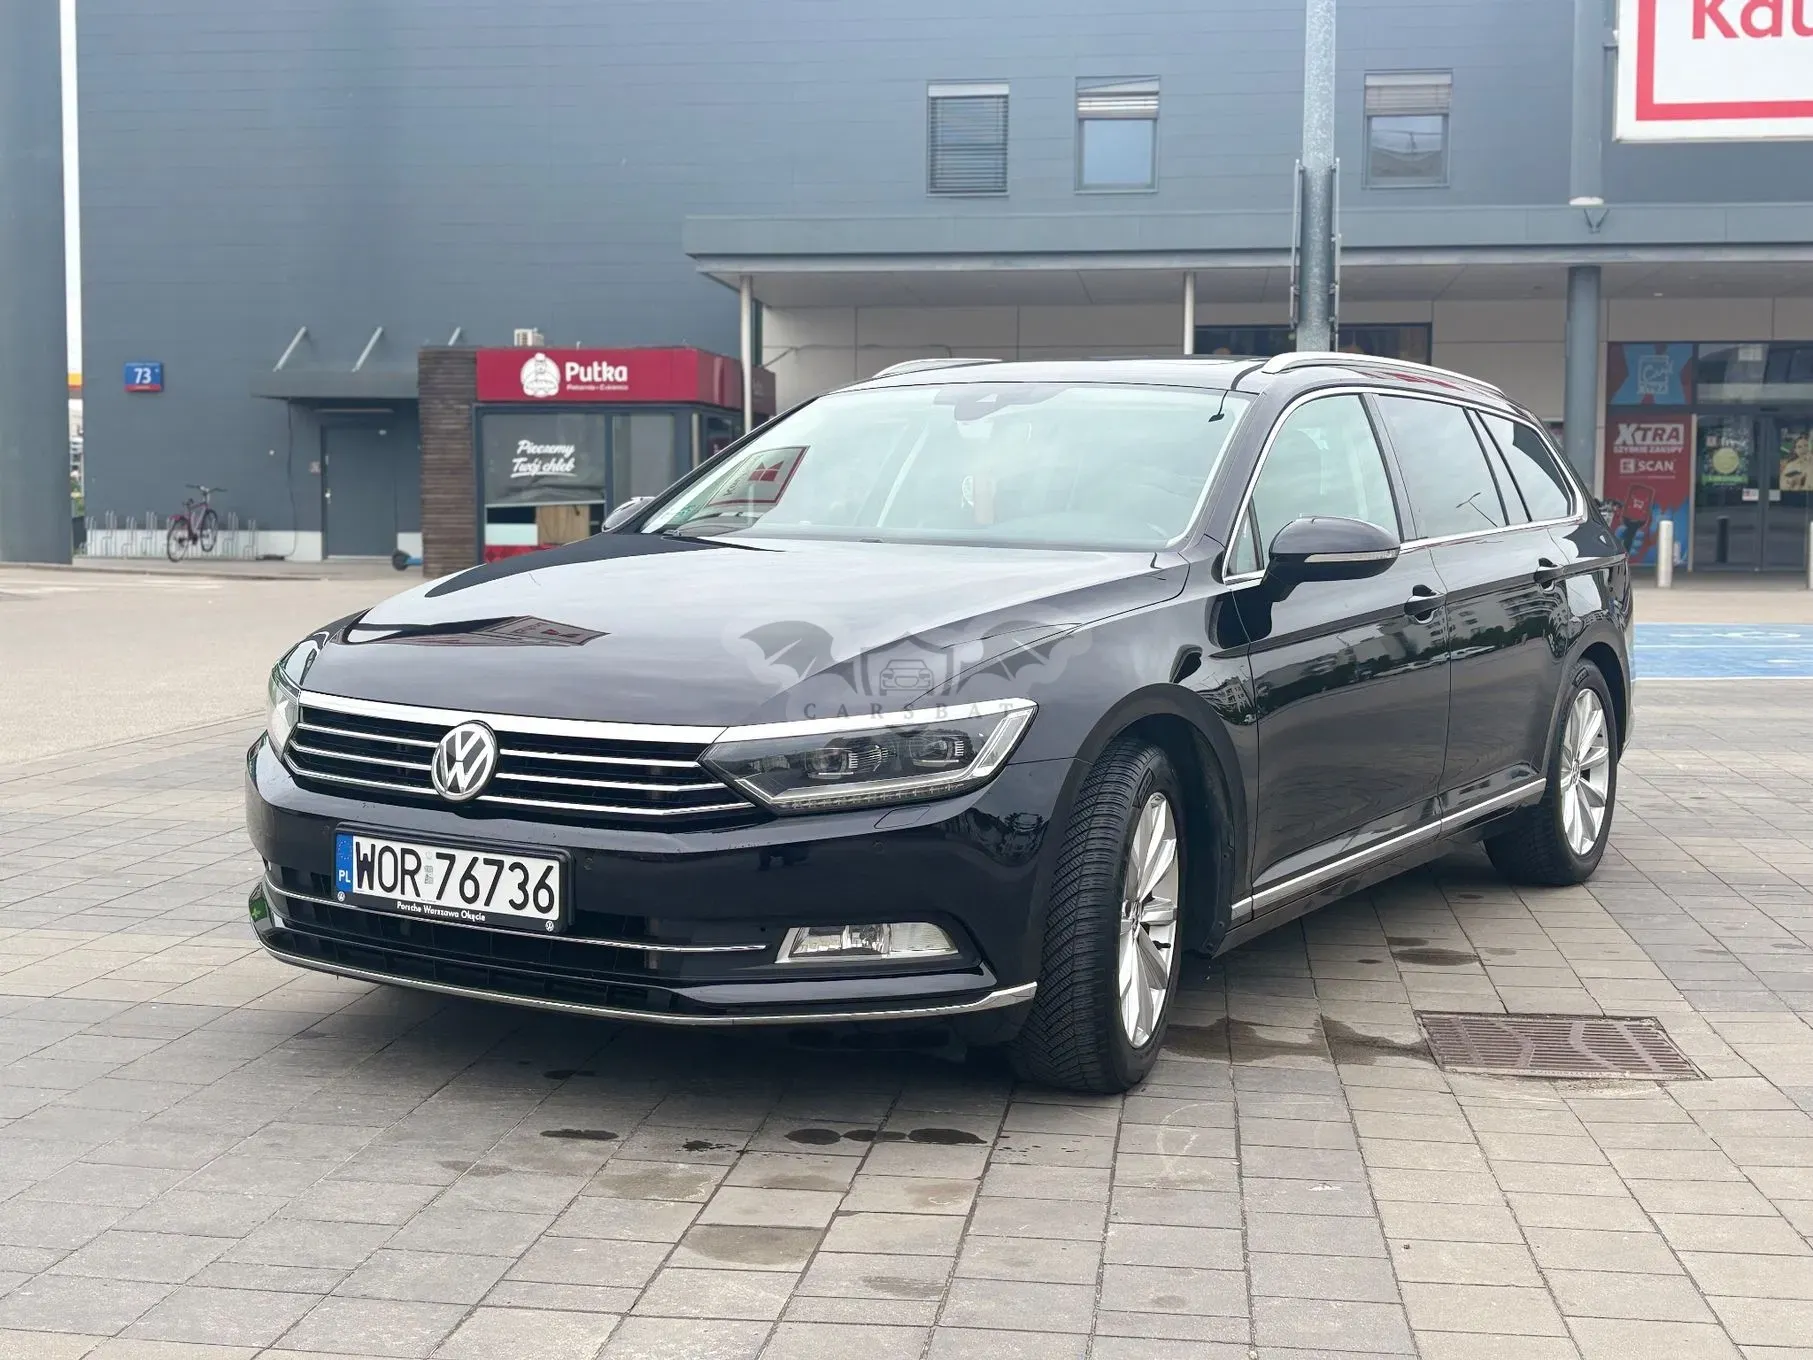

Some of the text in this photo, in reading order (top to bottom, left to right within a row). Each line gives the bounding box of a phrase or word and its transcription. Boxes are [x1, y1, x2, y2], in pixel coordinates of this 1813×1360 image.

[134, 368, 151, 384] 73
[565, 361, 628, 381] Putka
[1614, 423, 1683, 444] XTRA
[1638, 460, 1674, 472] SCAN
[338, 870, 351, 883] PL
[355, 841, 555, 914] WOR 76736
[396, 901, 422, 913] Porsche
[423, 904, 459, 918] Warszawa
